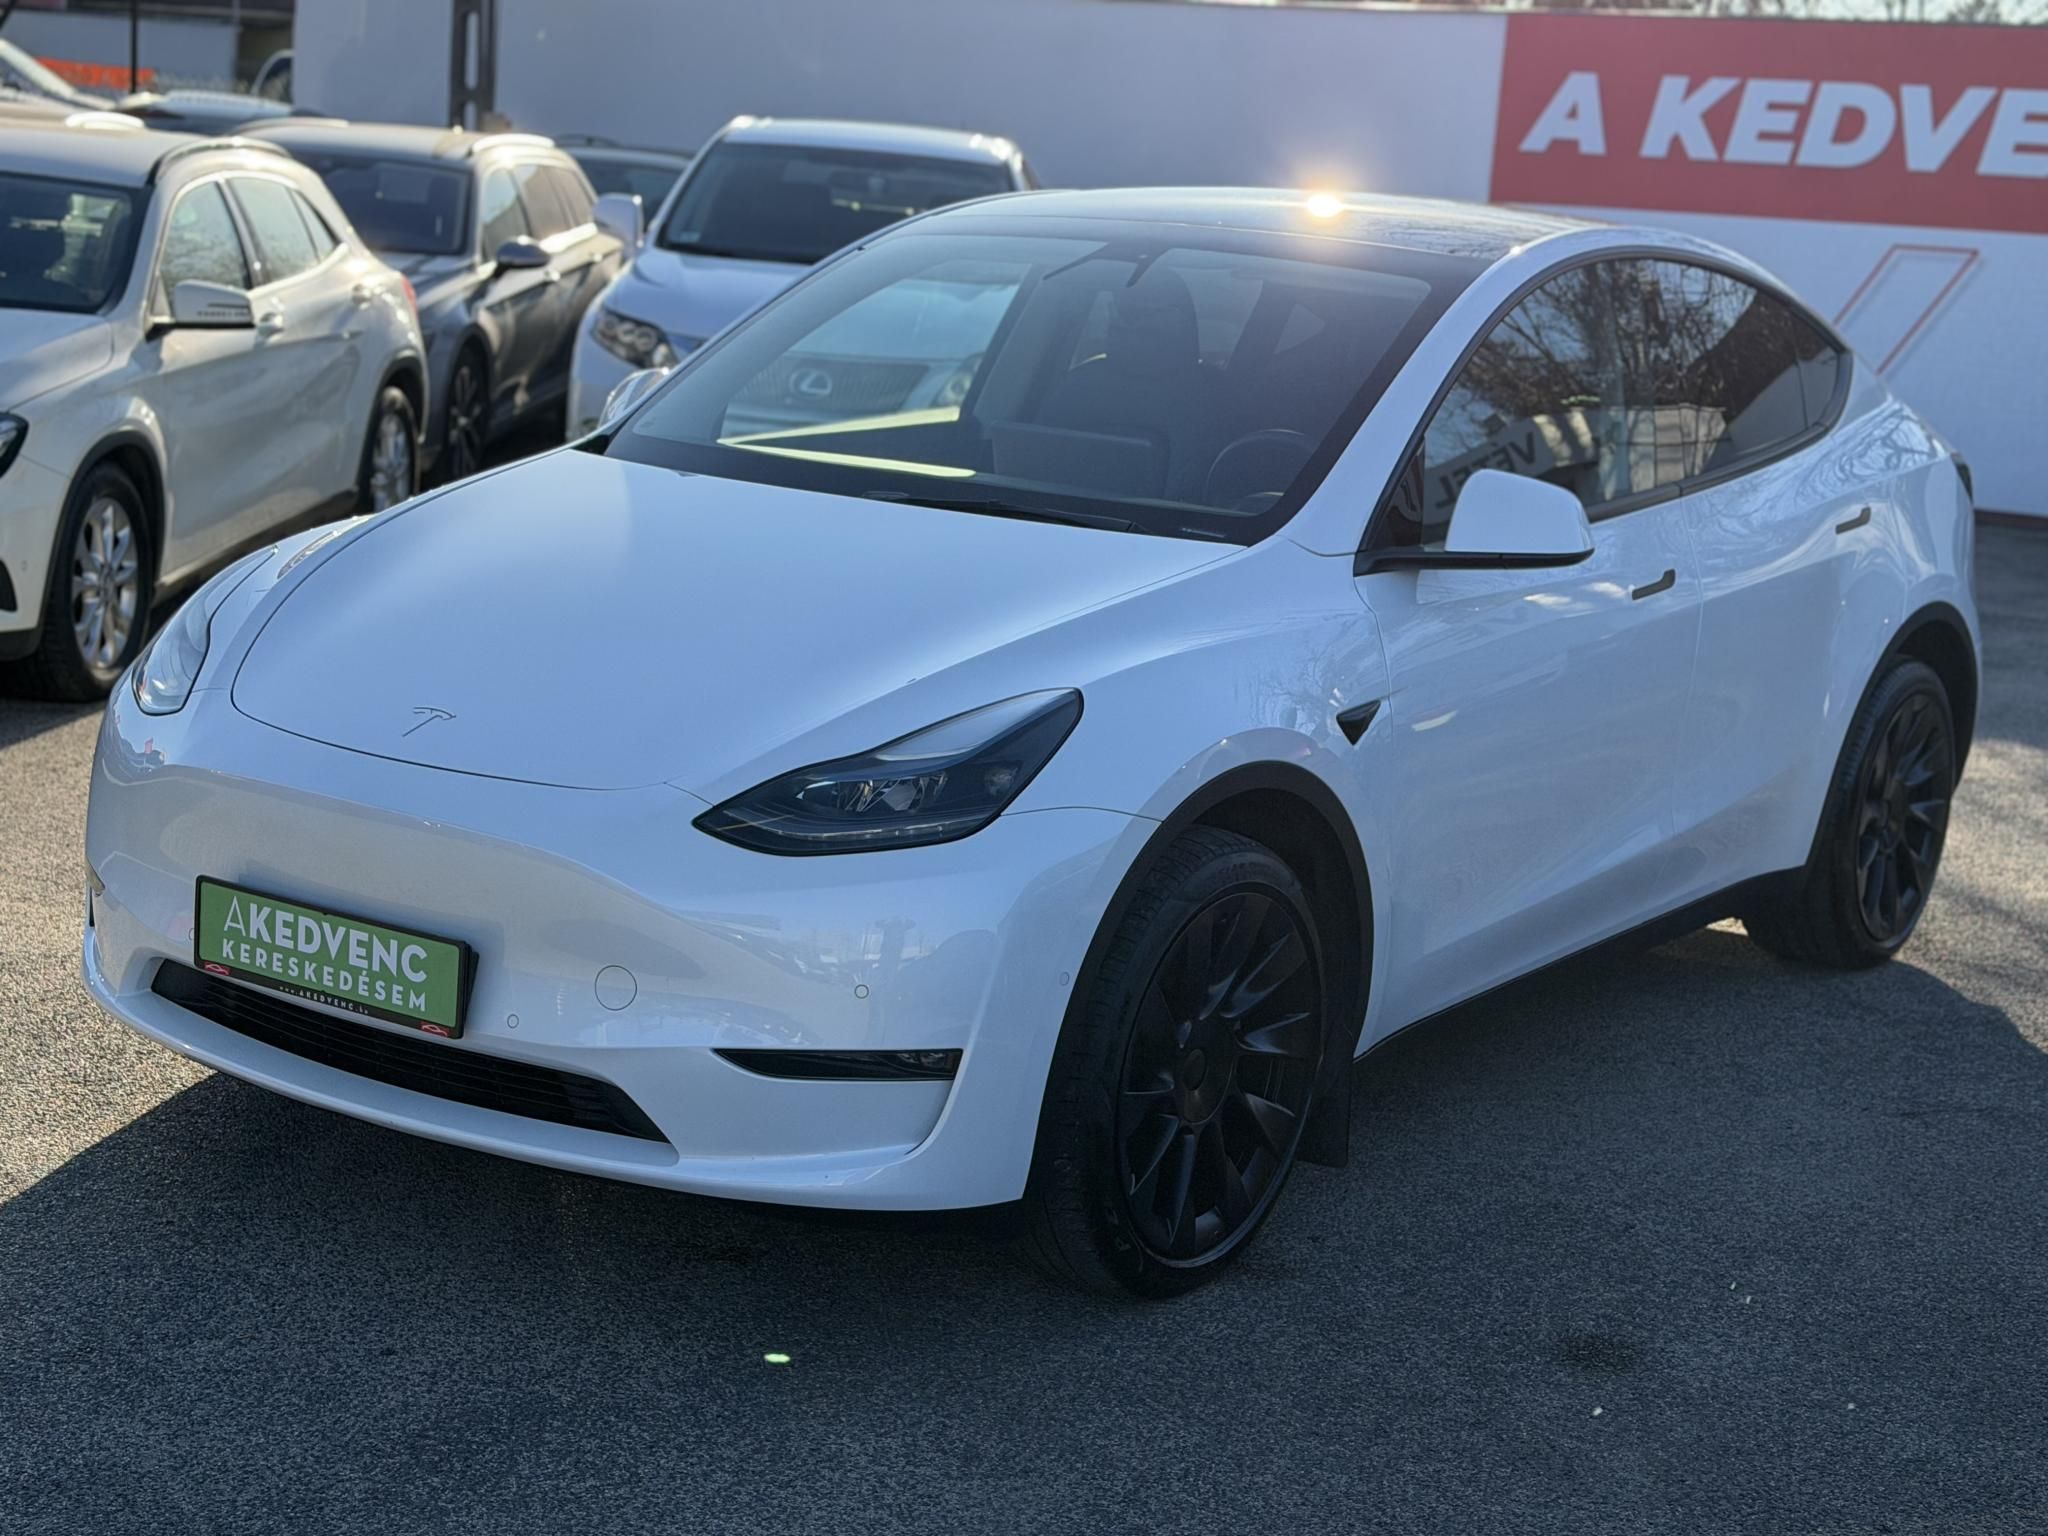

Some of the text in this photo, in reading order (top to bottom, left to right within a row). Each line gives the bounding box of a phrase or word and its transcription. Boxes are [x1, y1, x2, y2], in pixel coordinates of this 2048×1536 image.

[1519, 71, 2048, 178] A KEDVE
[222, 938, 428, 1012] KERESKEDÉSEM
